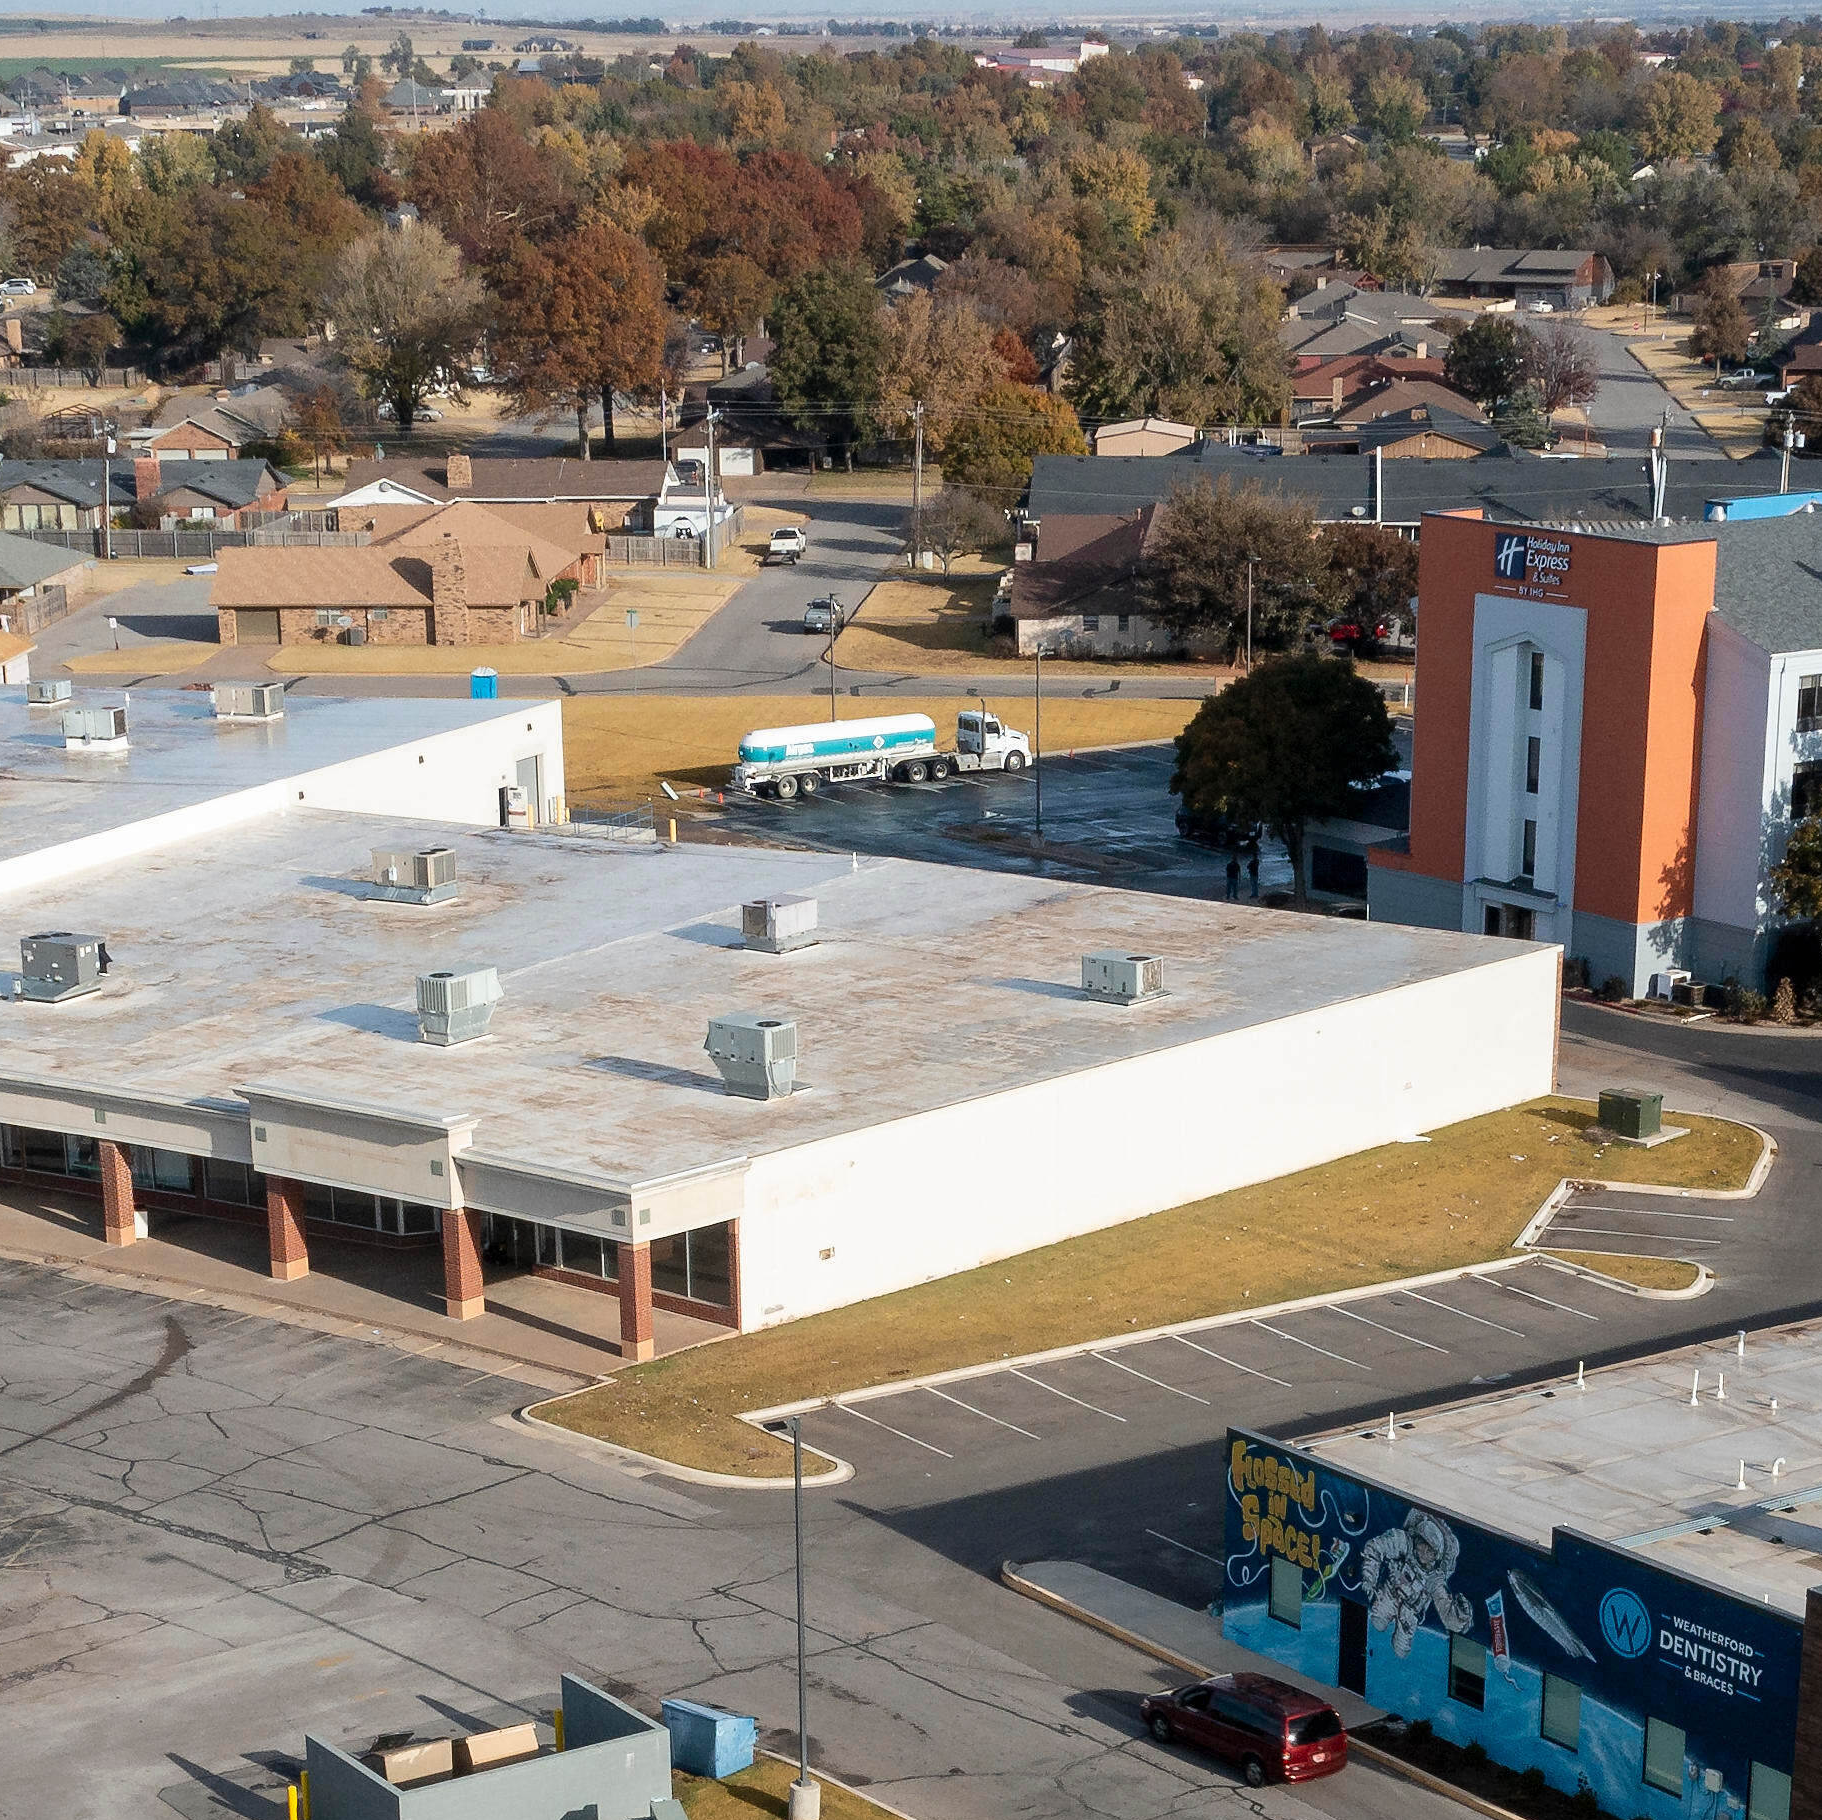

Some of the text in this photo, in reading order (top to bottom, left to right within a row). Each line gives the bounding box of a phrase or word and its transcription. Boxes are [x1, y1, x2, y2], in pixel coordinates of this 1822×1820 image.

[1527, 536, 1570, 554] Holiday Inn
[1526, 549, 1569, 571] Express
[1532, 572, 1539, 583] &
[1529, 587, 1544, 598] IHG
[1673, 1615, 1754, 1657] WEATHERFORD
[1659, 1630, 1764, 1687] DENTISTRY
[1684, 1666, 1734, 1696] & BRACES
